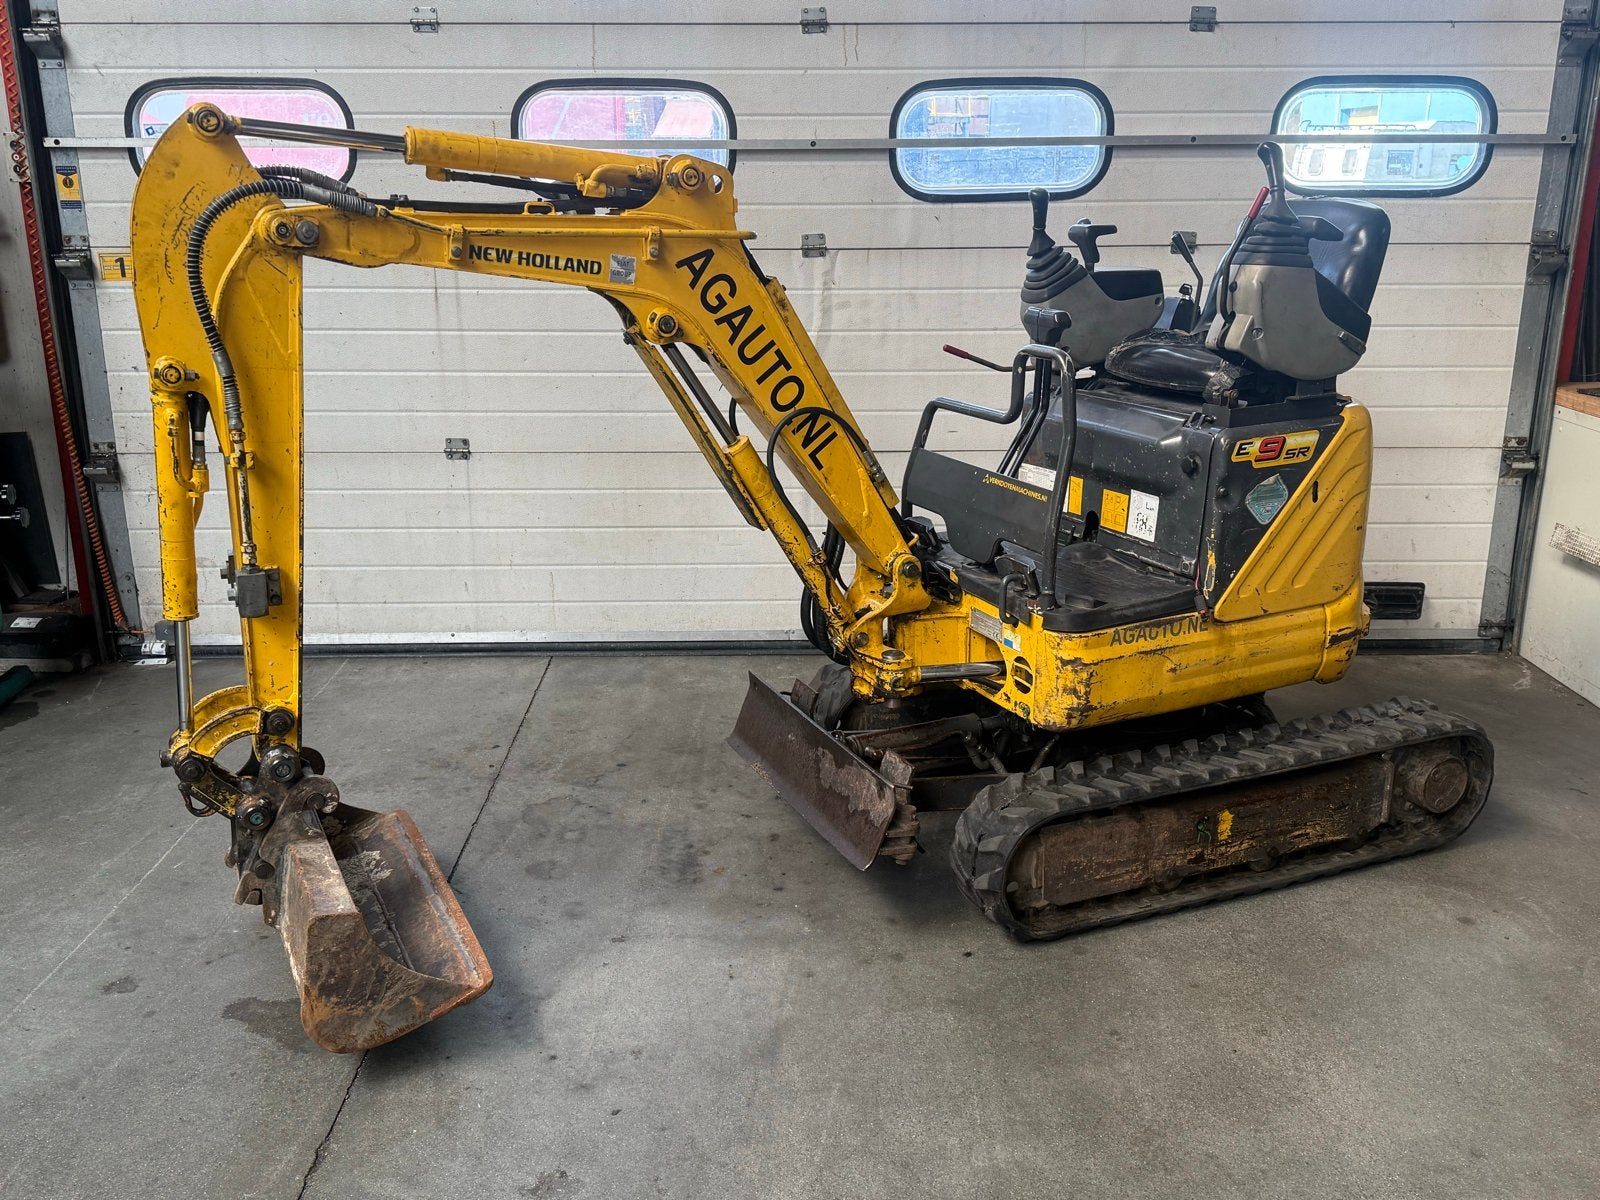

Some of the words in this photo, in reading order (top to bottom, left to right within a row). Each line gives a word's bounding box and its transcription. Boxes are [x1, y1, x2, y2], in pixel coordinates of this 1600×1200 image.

[114, 257, 126, 278] 1
[468, 244, 513, 264] NEW
[517, 251, 602, 276] HOLLAND
